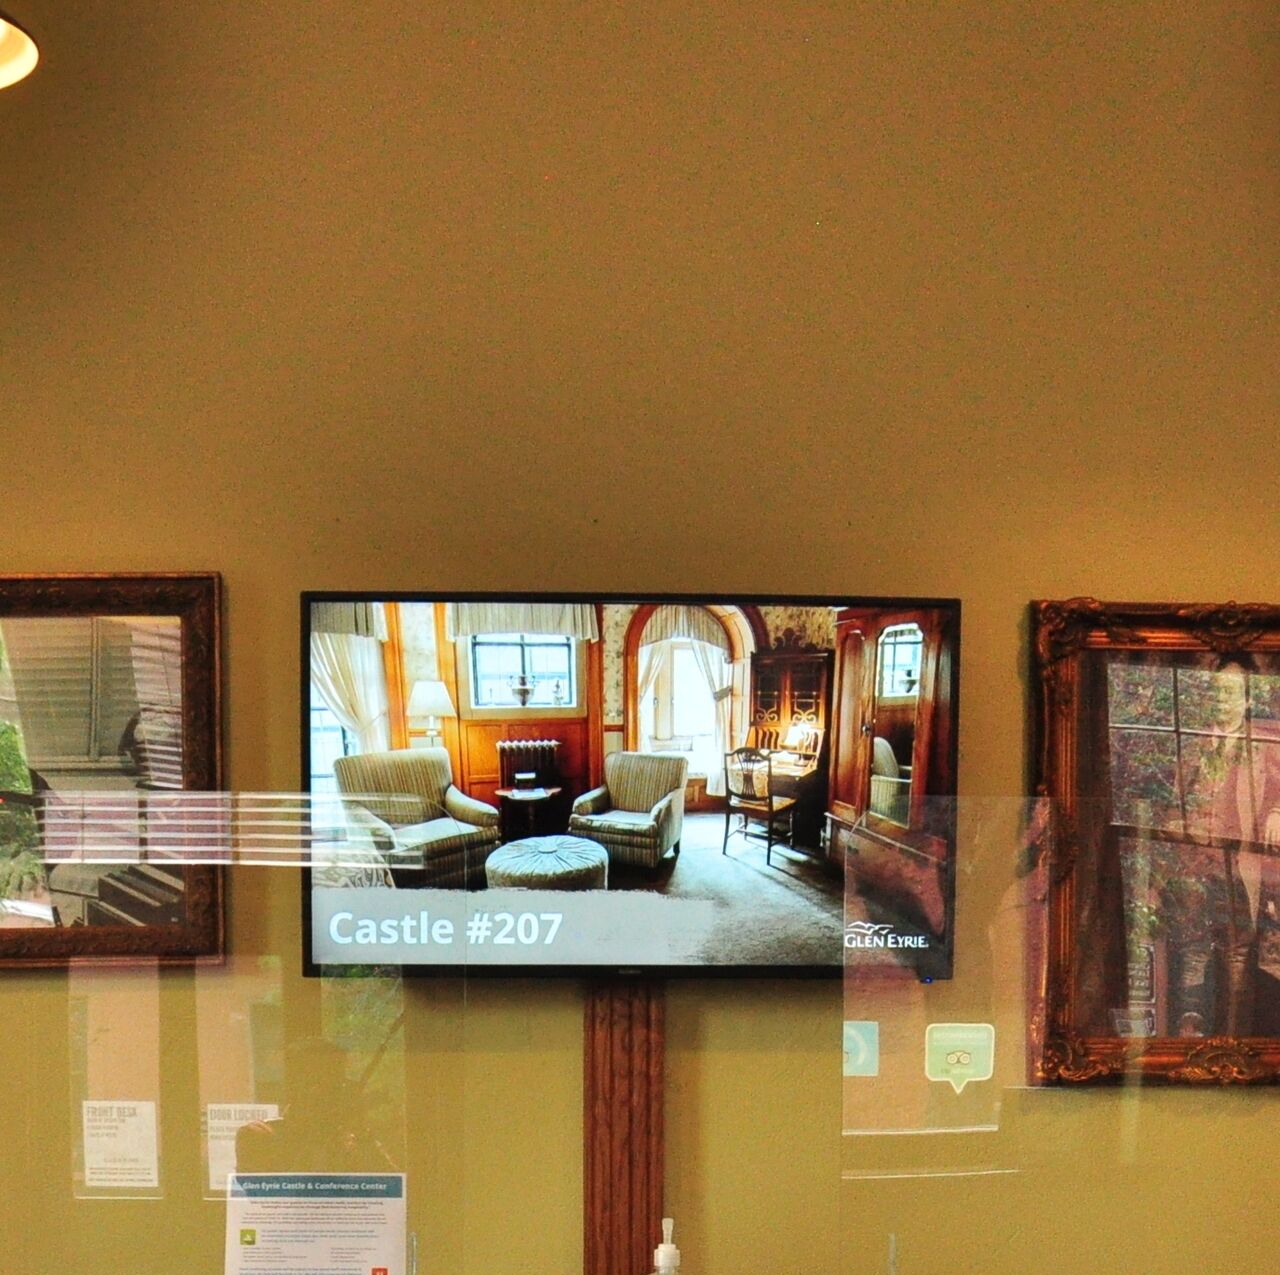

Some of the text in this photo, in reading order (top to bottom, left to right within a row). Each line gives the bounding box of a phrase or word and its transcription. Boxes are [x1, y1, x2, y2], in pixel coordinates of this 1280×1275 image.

[329, 911, 563, 945] Castle #207
[845, 934, 927, 948] GLEN EYRIE
[242, 1182, 387, 1191] Glen Eyrie Castle & Conference Center
